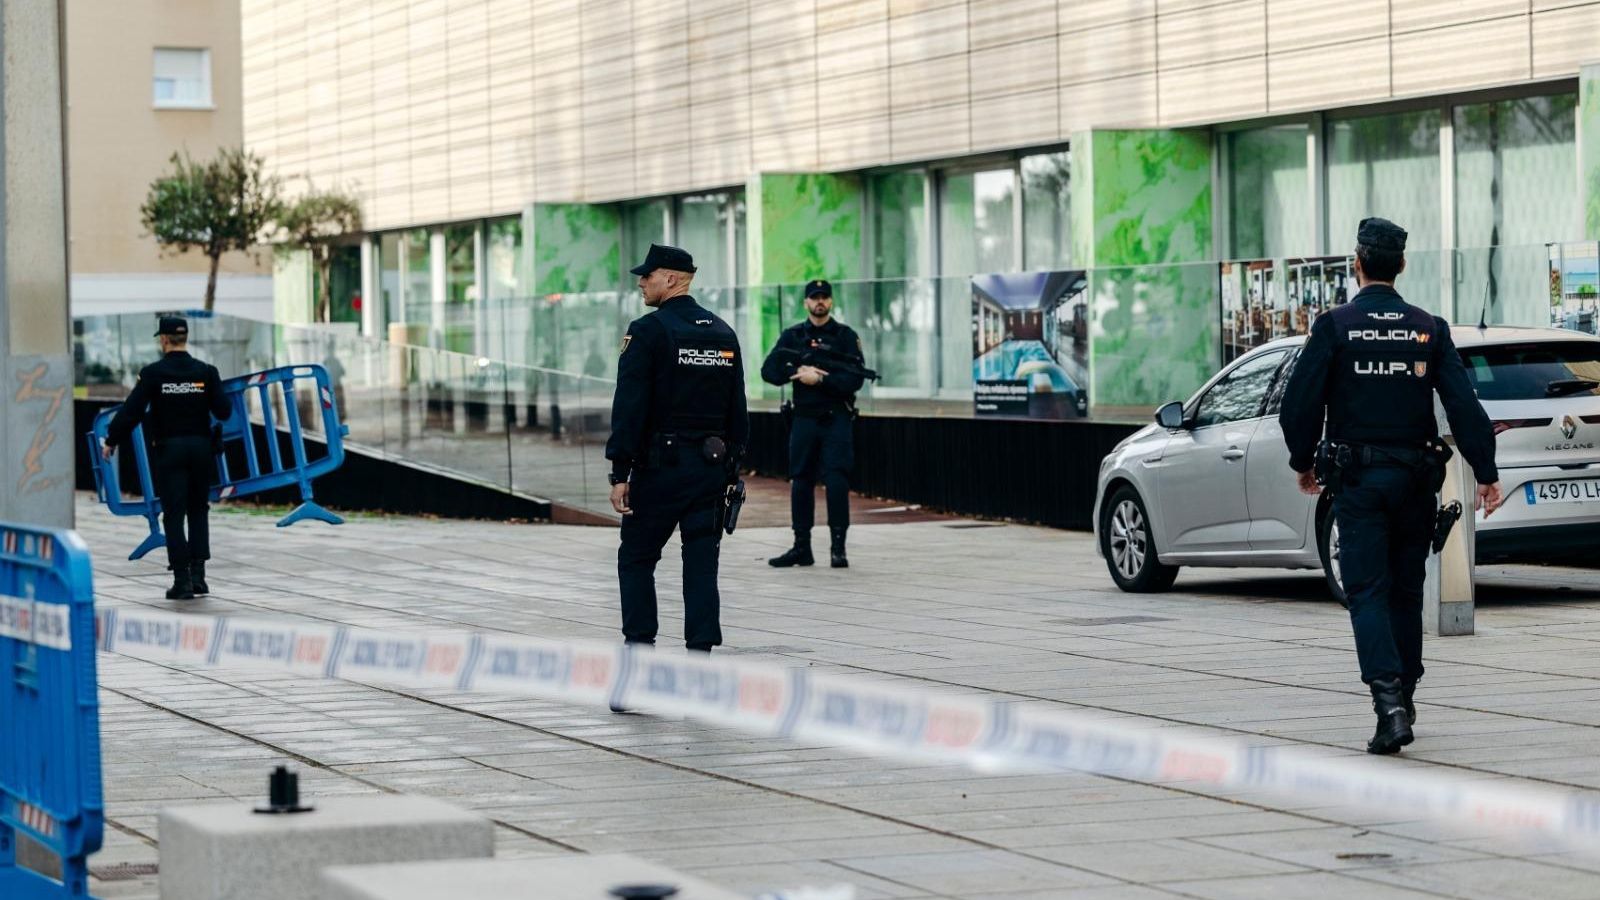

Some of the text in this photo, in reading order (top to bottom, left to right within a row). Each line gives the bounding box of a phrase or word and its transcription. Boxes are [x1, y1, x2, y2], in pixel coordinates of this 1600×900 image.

[1348, 329, 1419, 341] POLICIA
[678, 349, 723, 358] POLICIA
[678, 357, 733, 366] NACIONAL
[1354, 361, 1411, 375] U.I.P.
[1539, 483, 1580, 500] 4970
